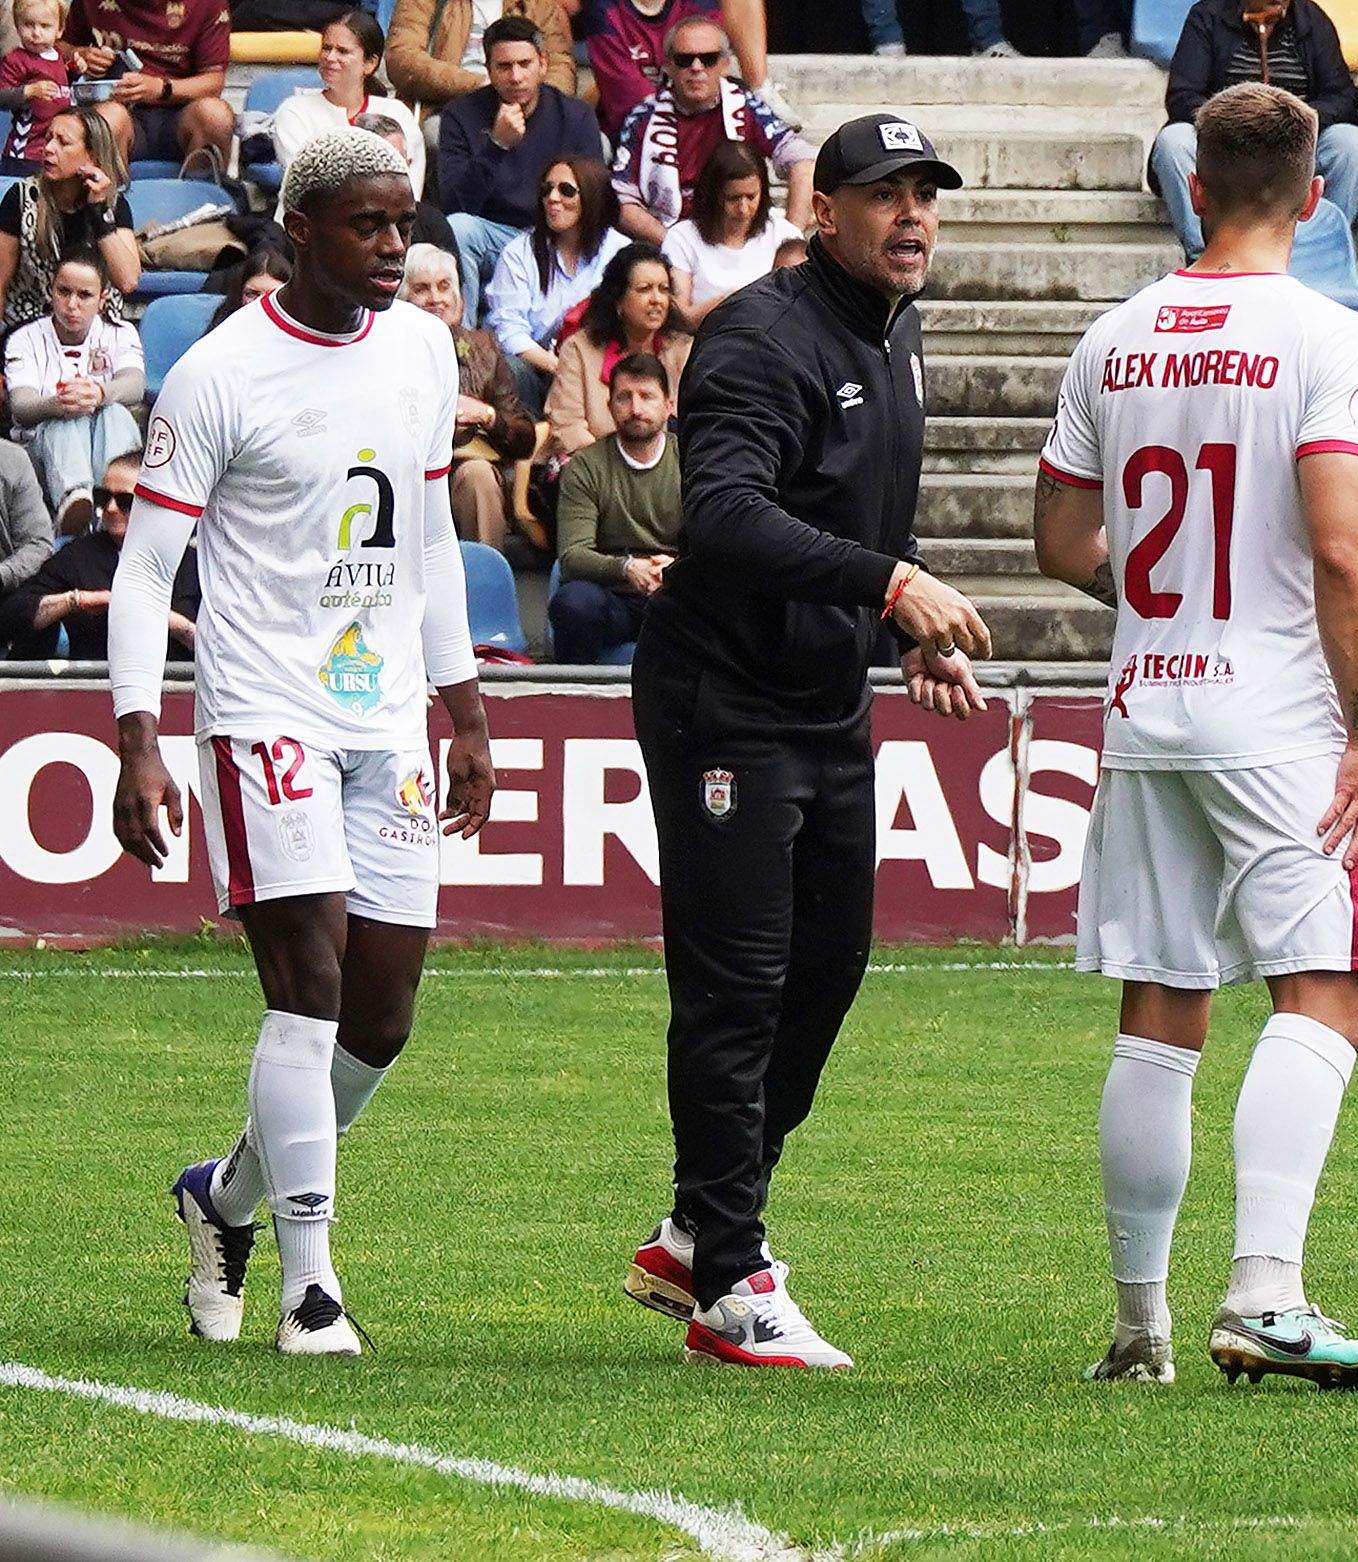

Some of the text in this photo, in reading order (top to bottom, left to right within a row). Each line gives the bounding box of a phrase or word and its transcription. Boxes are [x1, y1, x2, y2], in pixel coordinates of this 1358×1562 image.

[1100, 347, 1280, 395] ÁLEX MORENO
[1121, 442, 1238, 621] 21
[251, 735, 314, 806] 12
